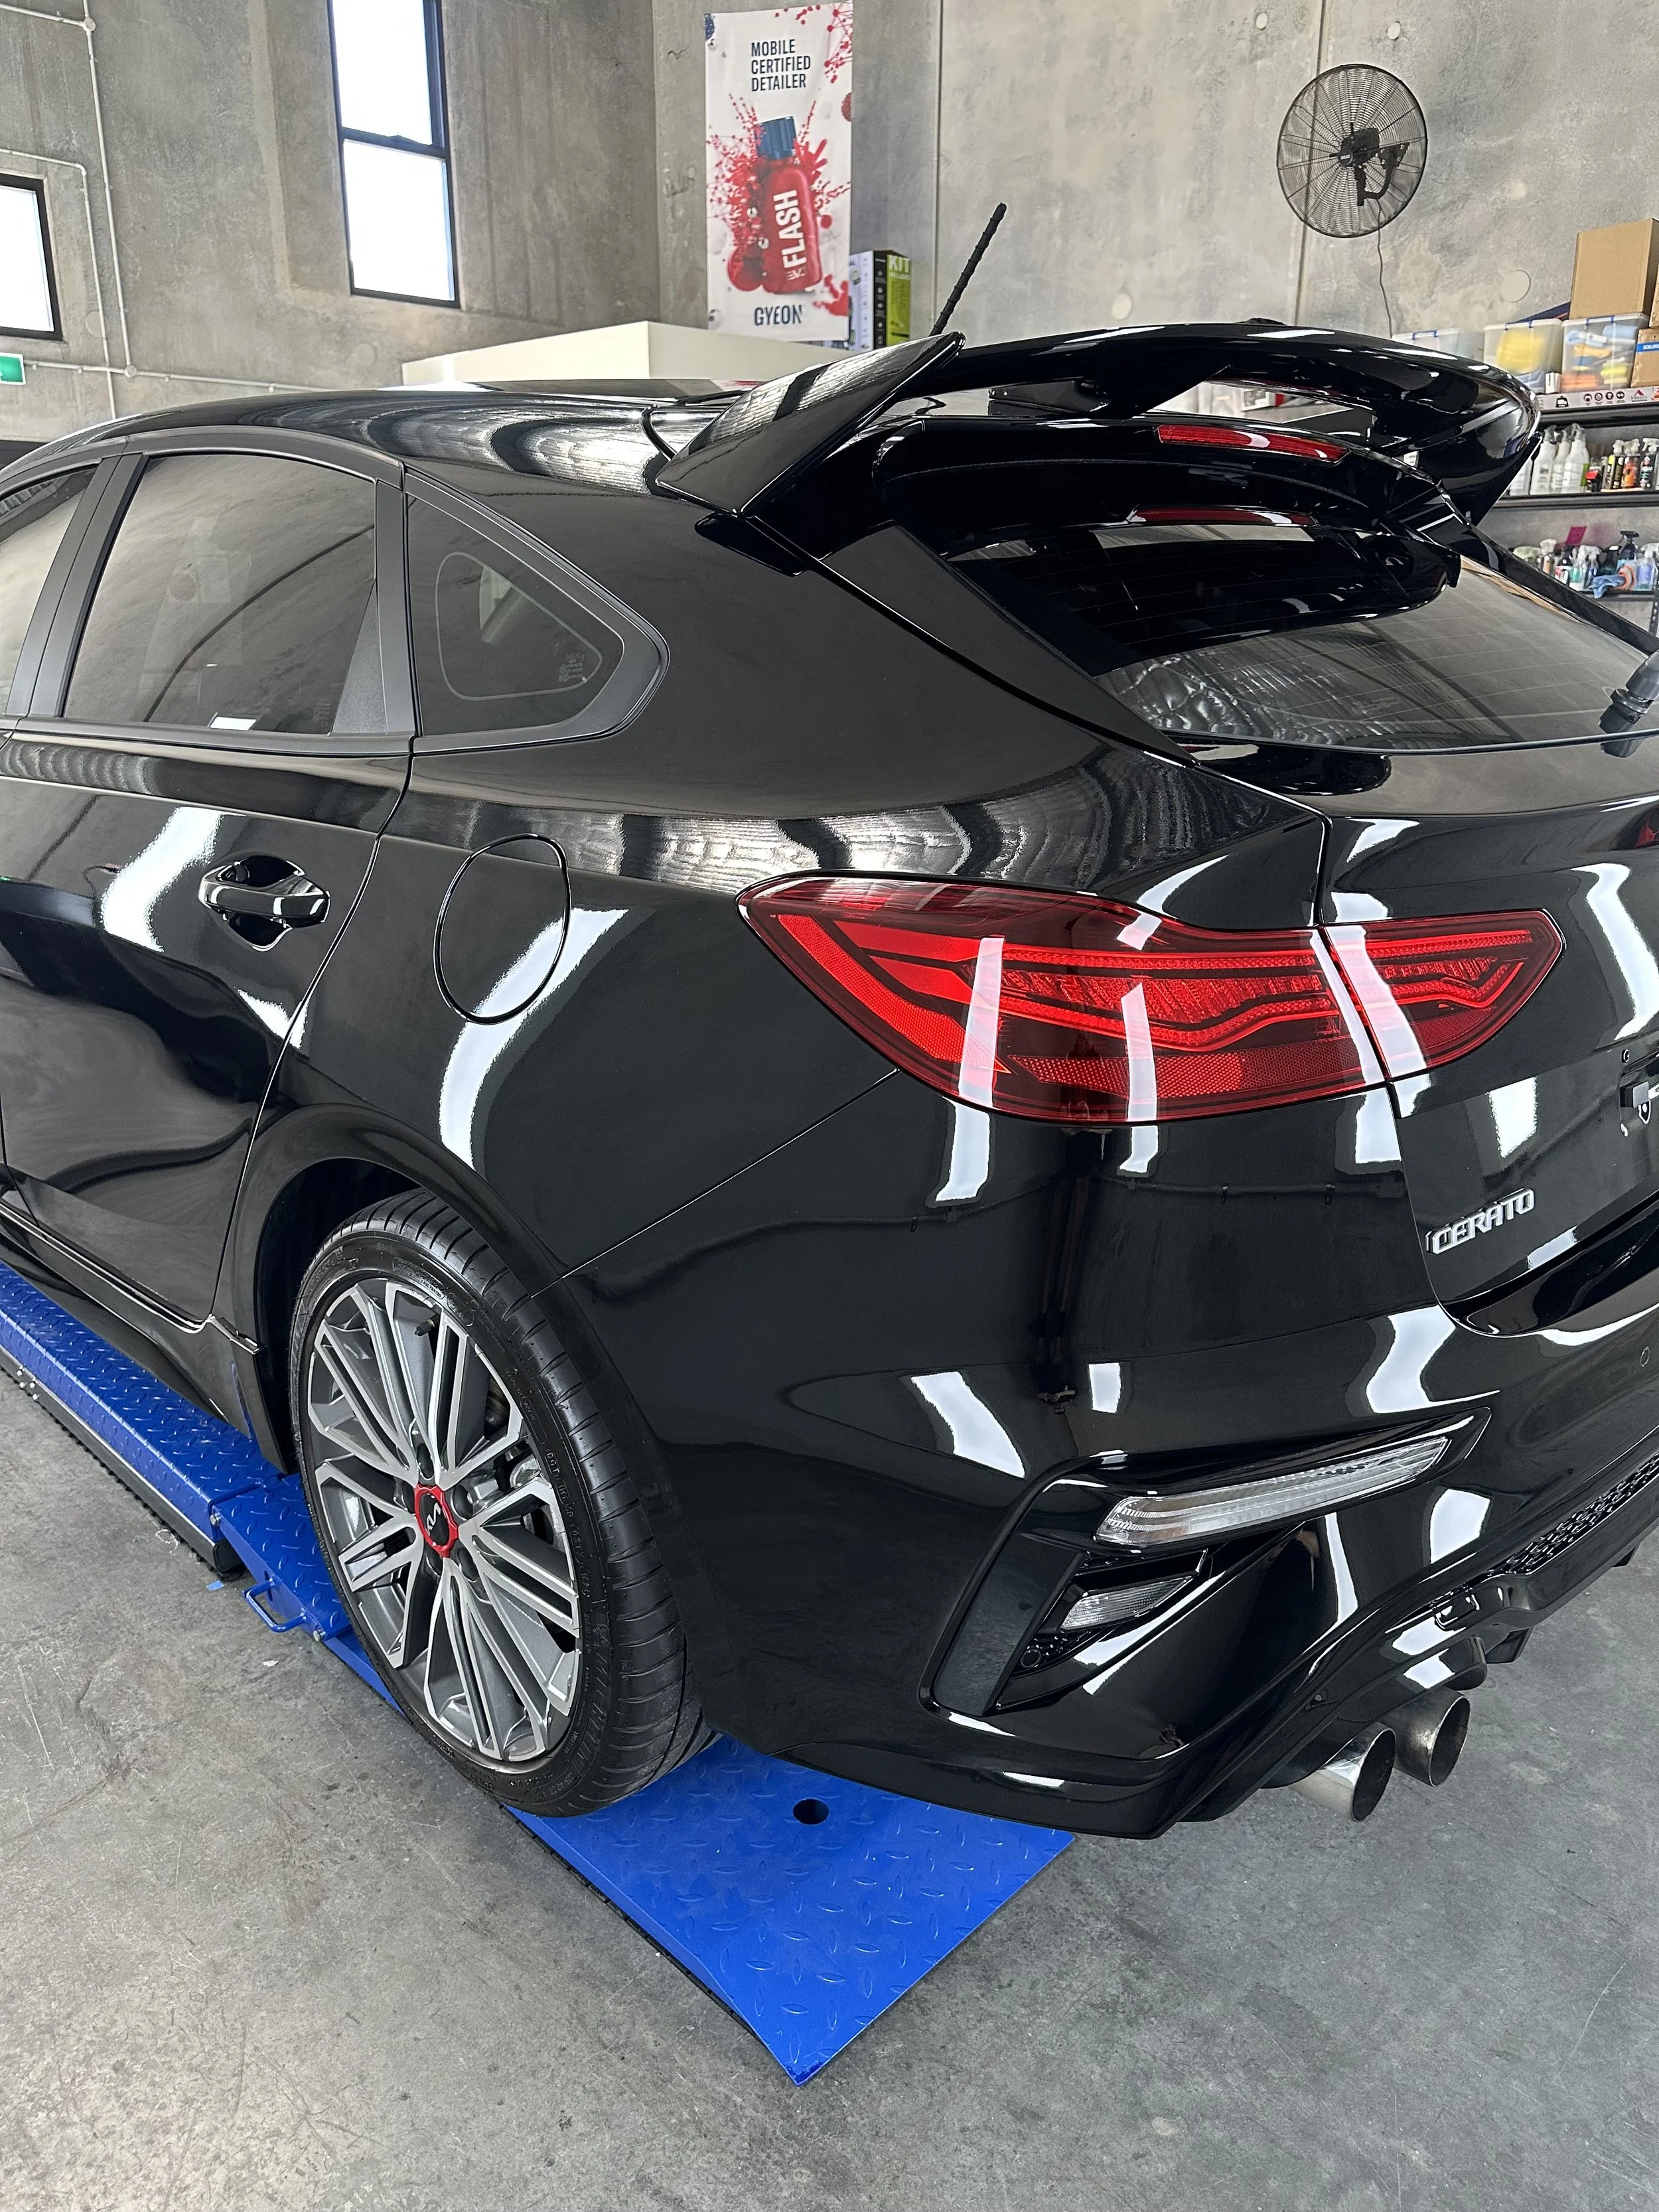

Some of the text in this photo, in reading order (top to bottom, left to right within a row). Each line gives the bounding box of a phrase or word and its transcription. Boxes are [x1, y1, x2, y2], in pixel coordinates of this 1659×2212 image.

[751, 39, 795, 56] MOBILE
[751, 56, 811, 74] CERTIFIED
[752, 74, 806, 92] DETAILER
[772, 190, 807, 269] FLASH
[755, 305, 802, 326] GYEON
[1426, 1188, 1535, 1254] CERATO
